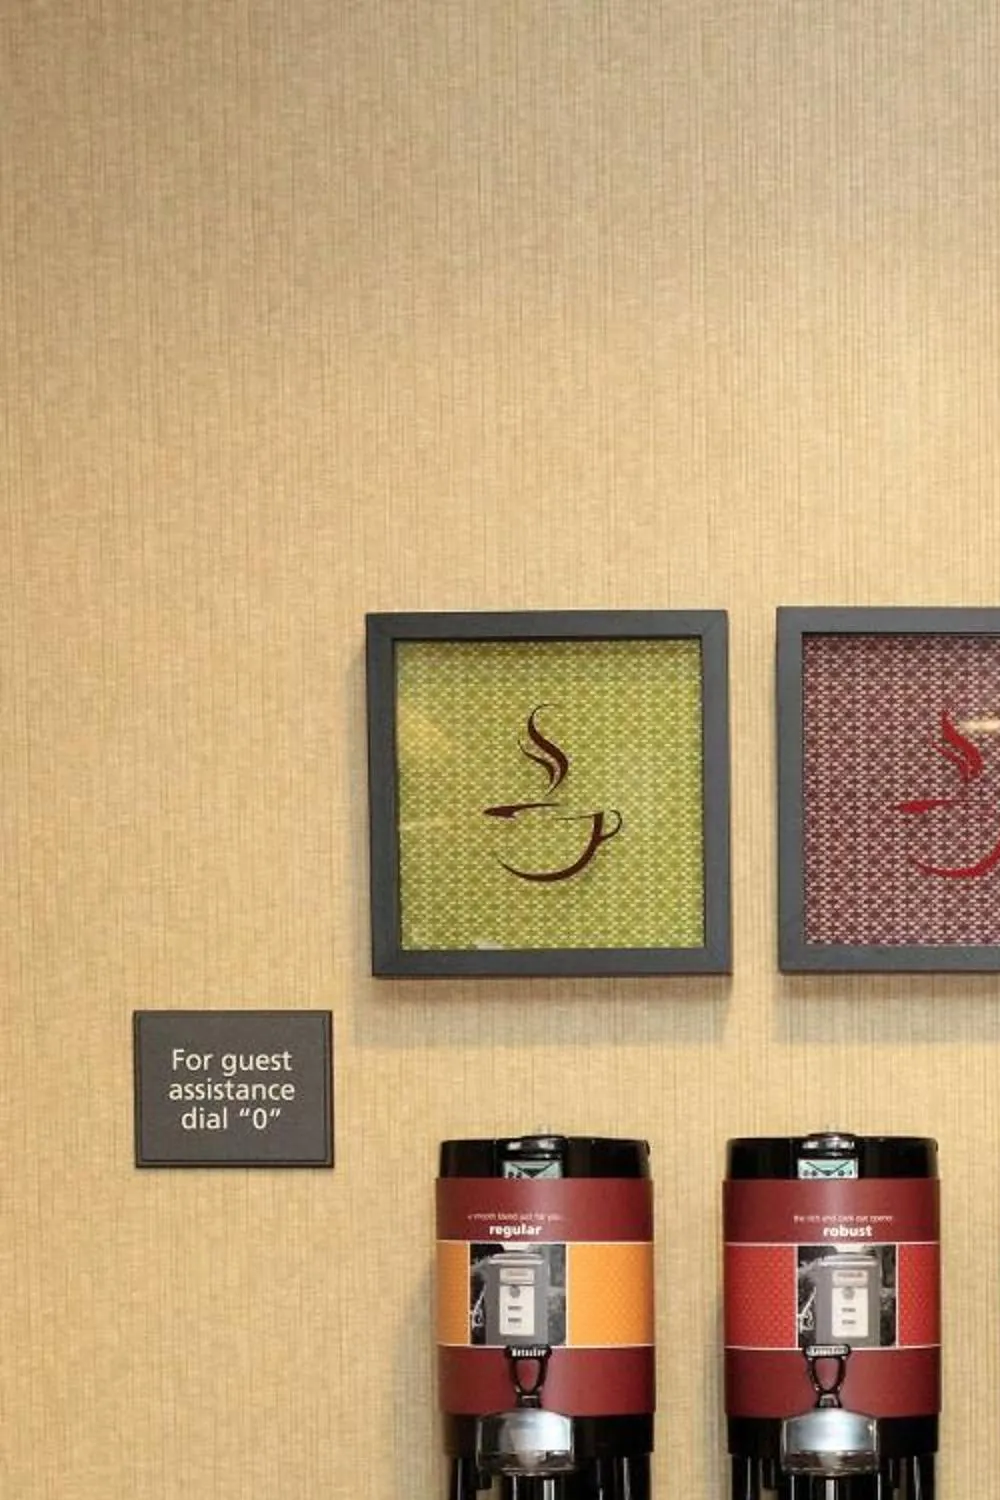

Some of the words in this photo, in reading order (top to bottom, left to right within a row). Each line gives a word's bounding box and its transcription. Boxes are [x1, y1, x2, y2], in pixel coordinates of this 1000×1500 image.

[172, 1048, 213, 1071] For
[221, 1050, 293, 1077] guest
[168, 1078, 296, 1101] assistance
[181, 1106, 228, 1130] dial
[489, 1223, 542, 1239] regular
[823, 1224, 873, 1237] robust
